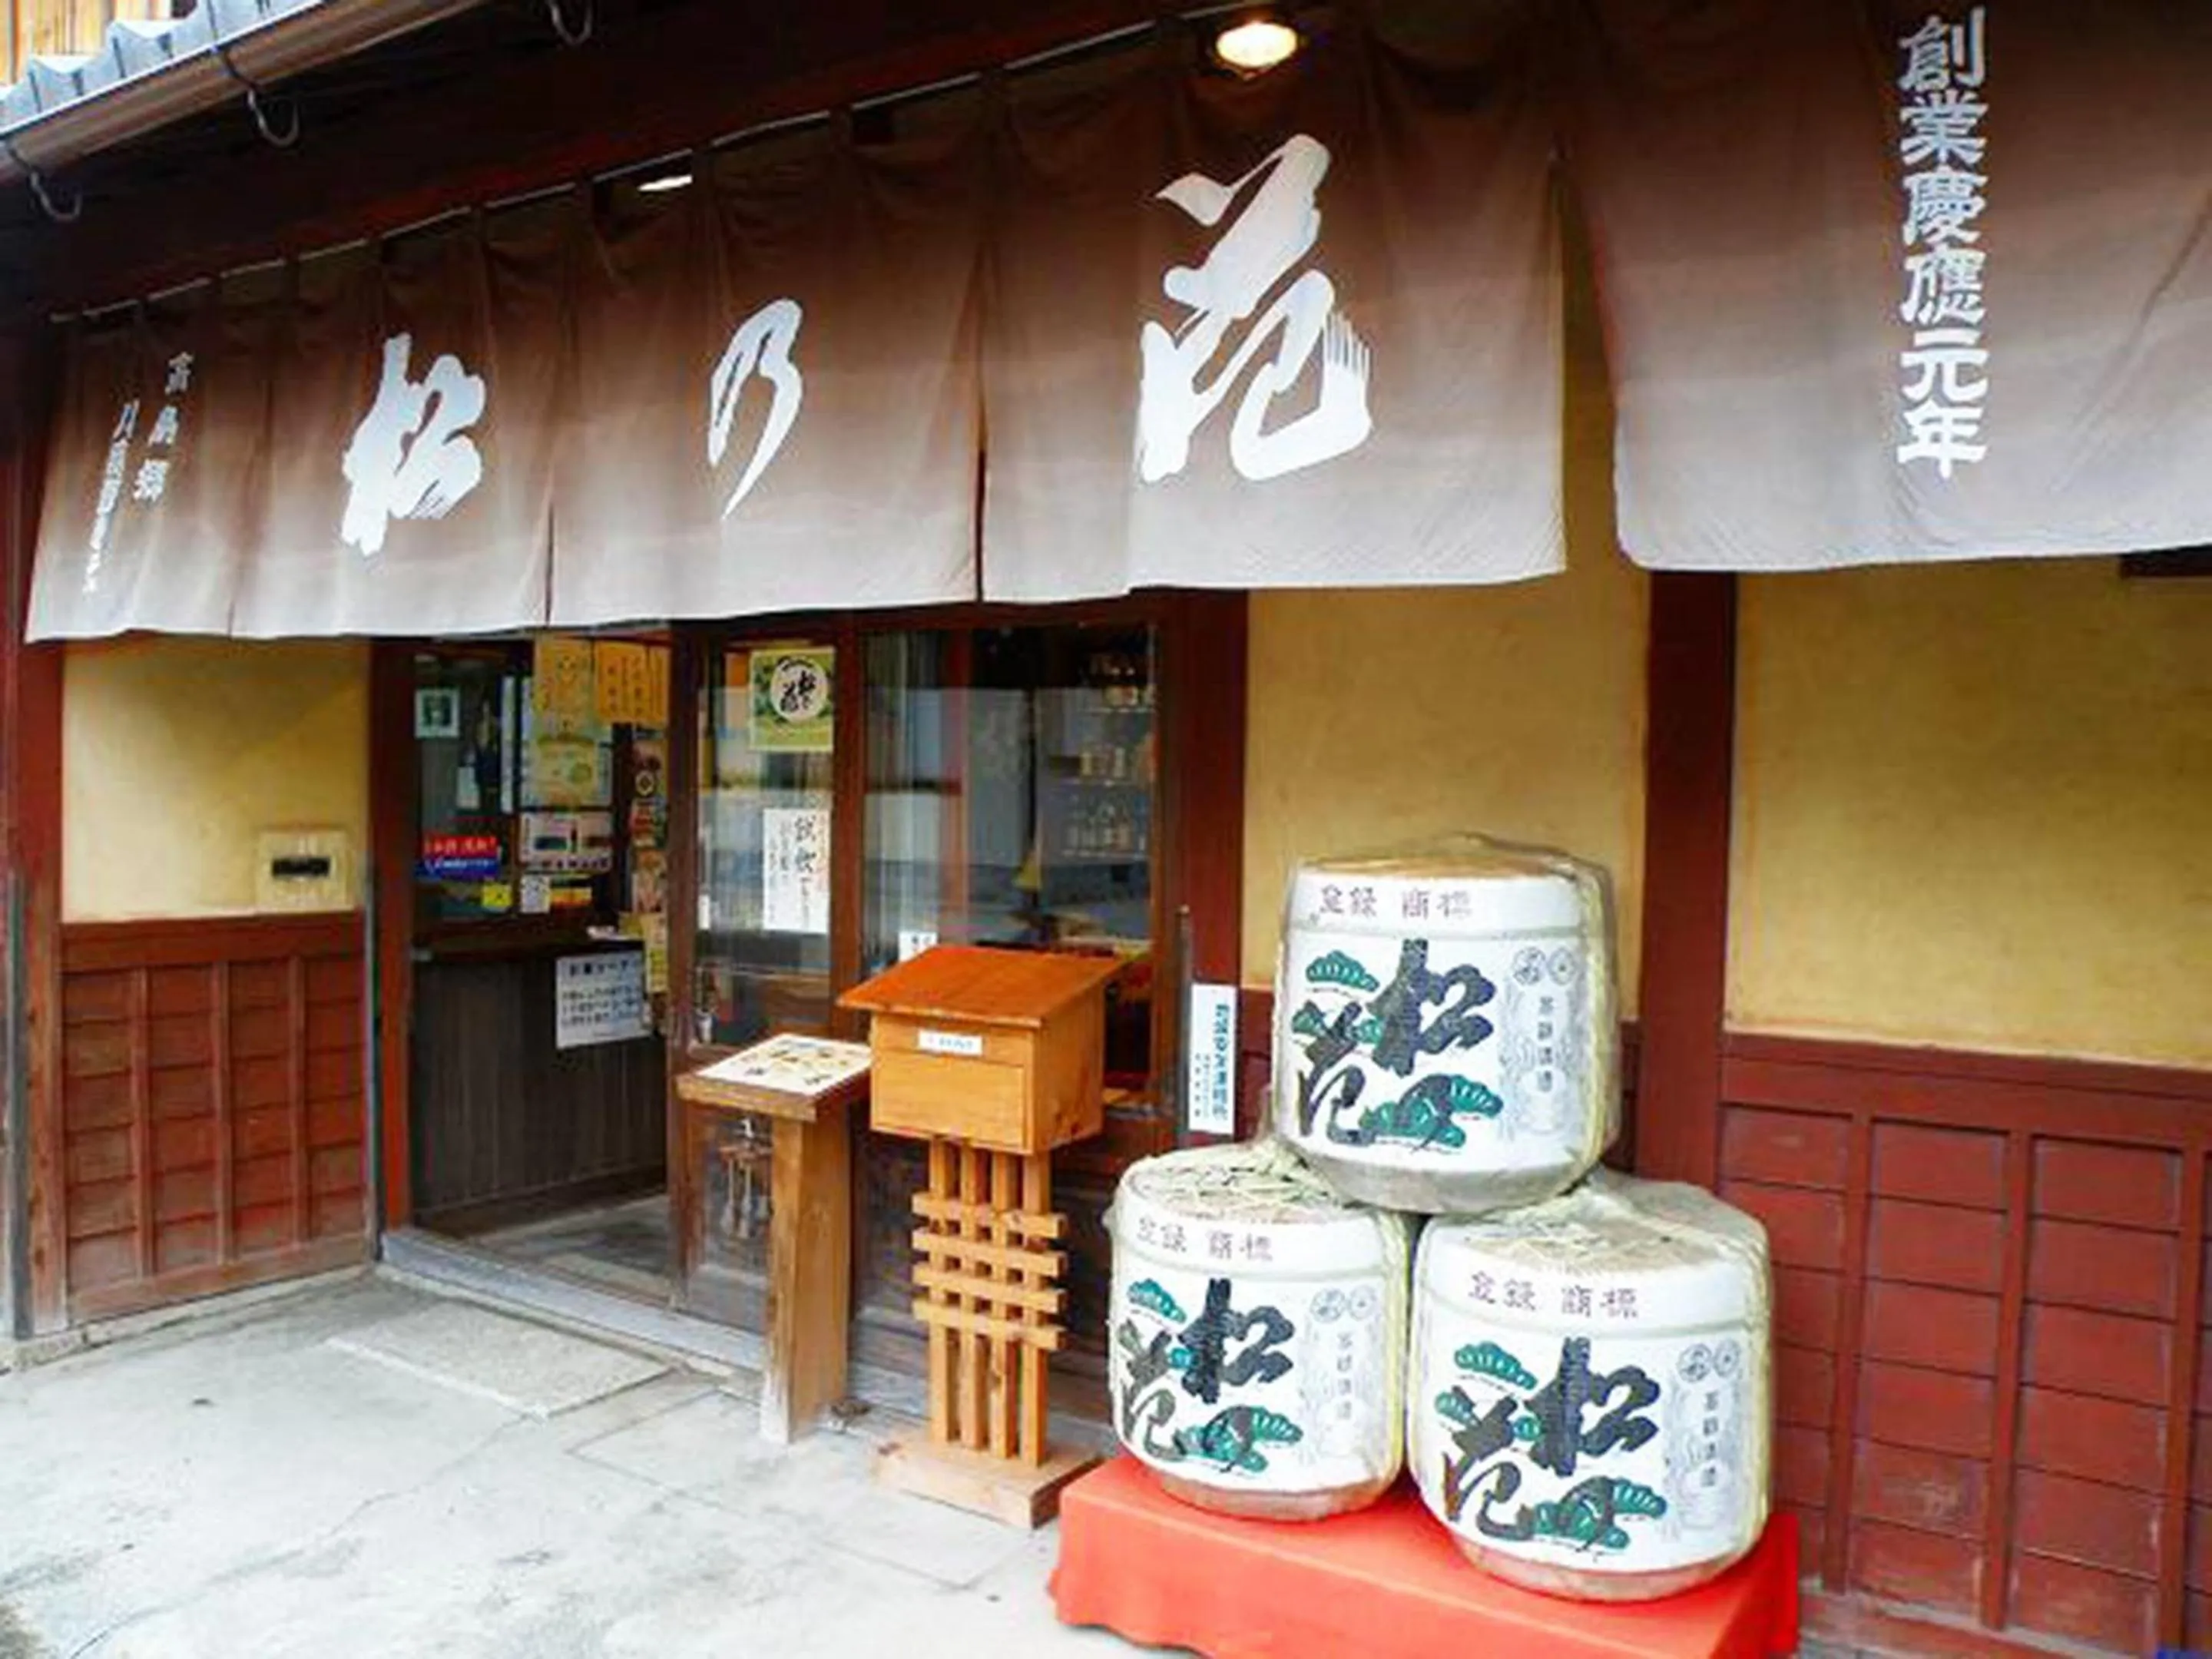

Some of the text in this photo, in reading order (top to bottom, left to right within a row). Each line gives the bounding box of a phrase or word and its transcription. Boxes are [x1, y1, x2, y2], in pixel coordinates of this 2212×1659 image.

[1899, 6, 1989, 481] 創業慶應元年
